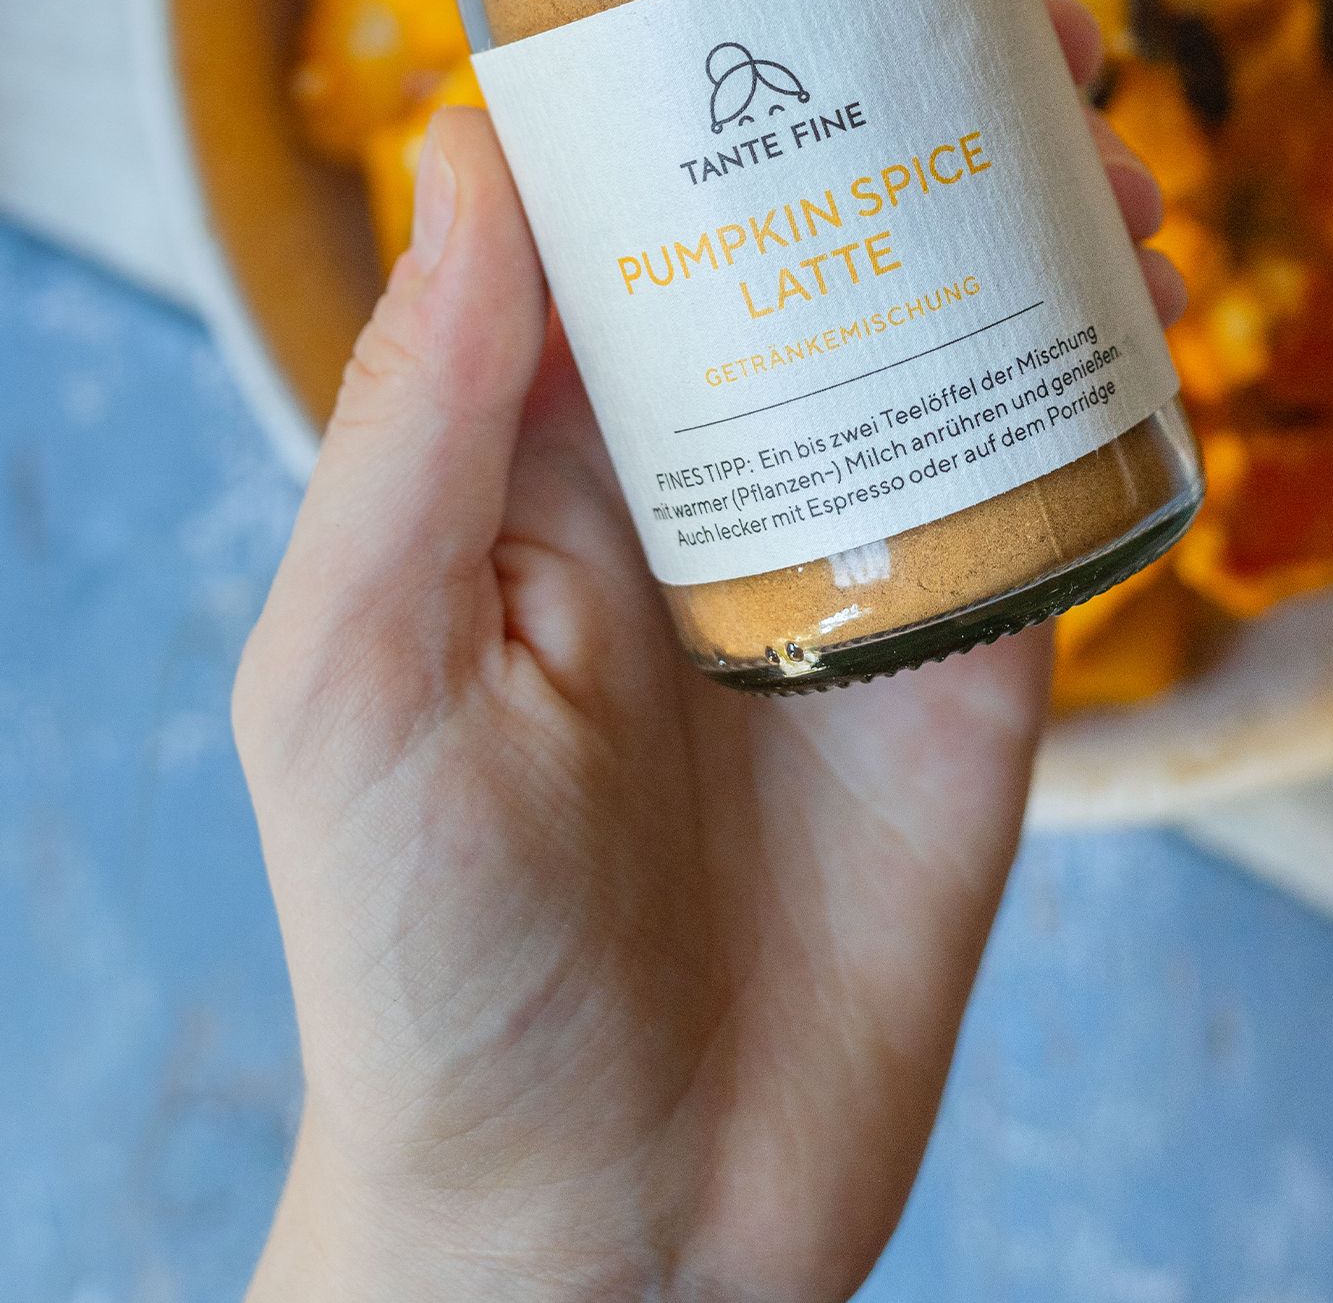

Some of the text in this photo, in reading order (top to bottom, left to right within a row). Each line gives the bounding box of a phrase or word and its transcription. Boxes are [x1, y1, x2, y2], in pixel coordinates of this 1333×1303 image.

[616, 131, 992, 295] PUMPKIN SPICE
[680, 101, 867, 185] TANTE FINE
[704, 275, 981, 387] GETRÄNKEMISCHUNG
[739, 231, 901, 320] LATTE
[653, 503, 673, 520] mit
[674, 496, 728, 519] warmer
[731, 460, 842, 511] (Pflanzen-)
[844, 440, 908, 475] Milch
[911, 402, 1009, 452] anrühren
[1011, 379, 1049, 410] und
[656, 325, 1098, 491] FINES TIPP: Ein bis zwei Teelöffel der Mischung
[677, 380, 1116, 547] Auch lecker mit Espresso oder auf dem Porridge
